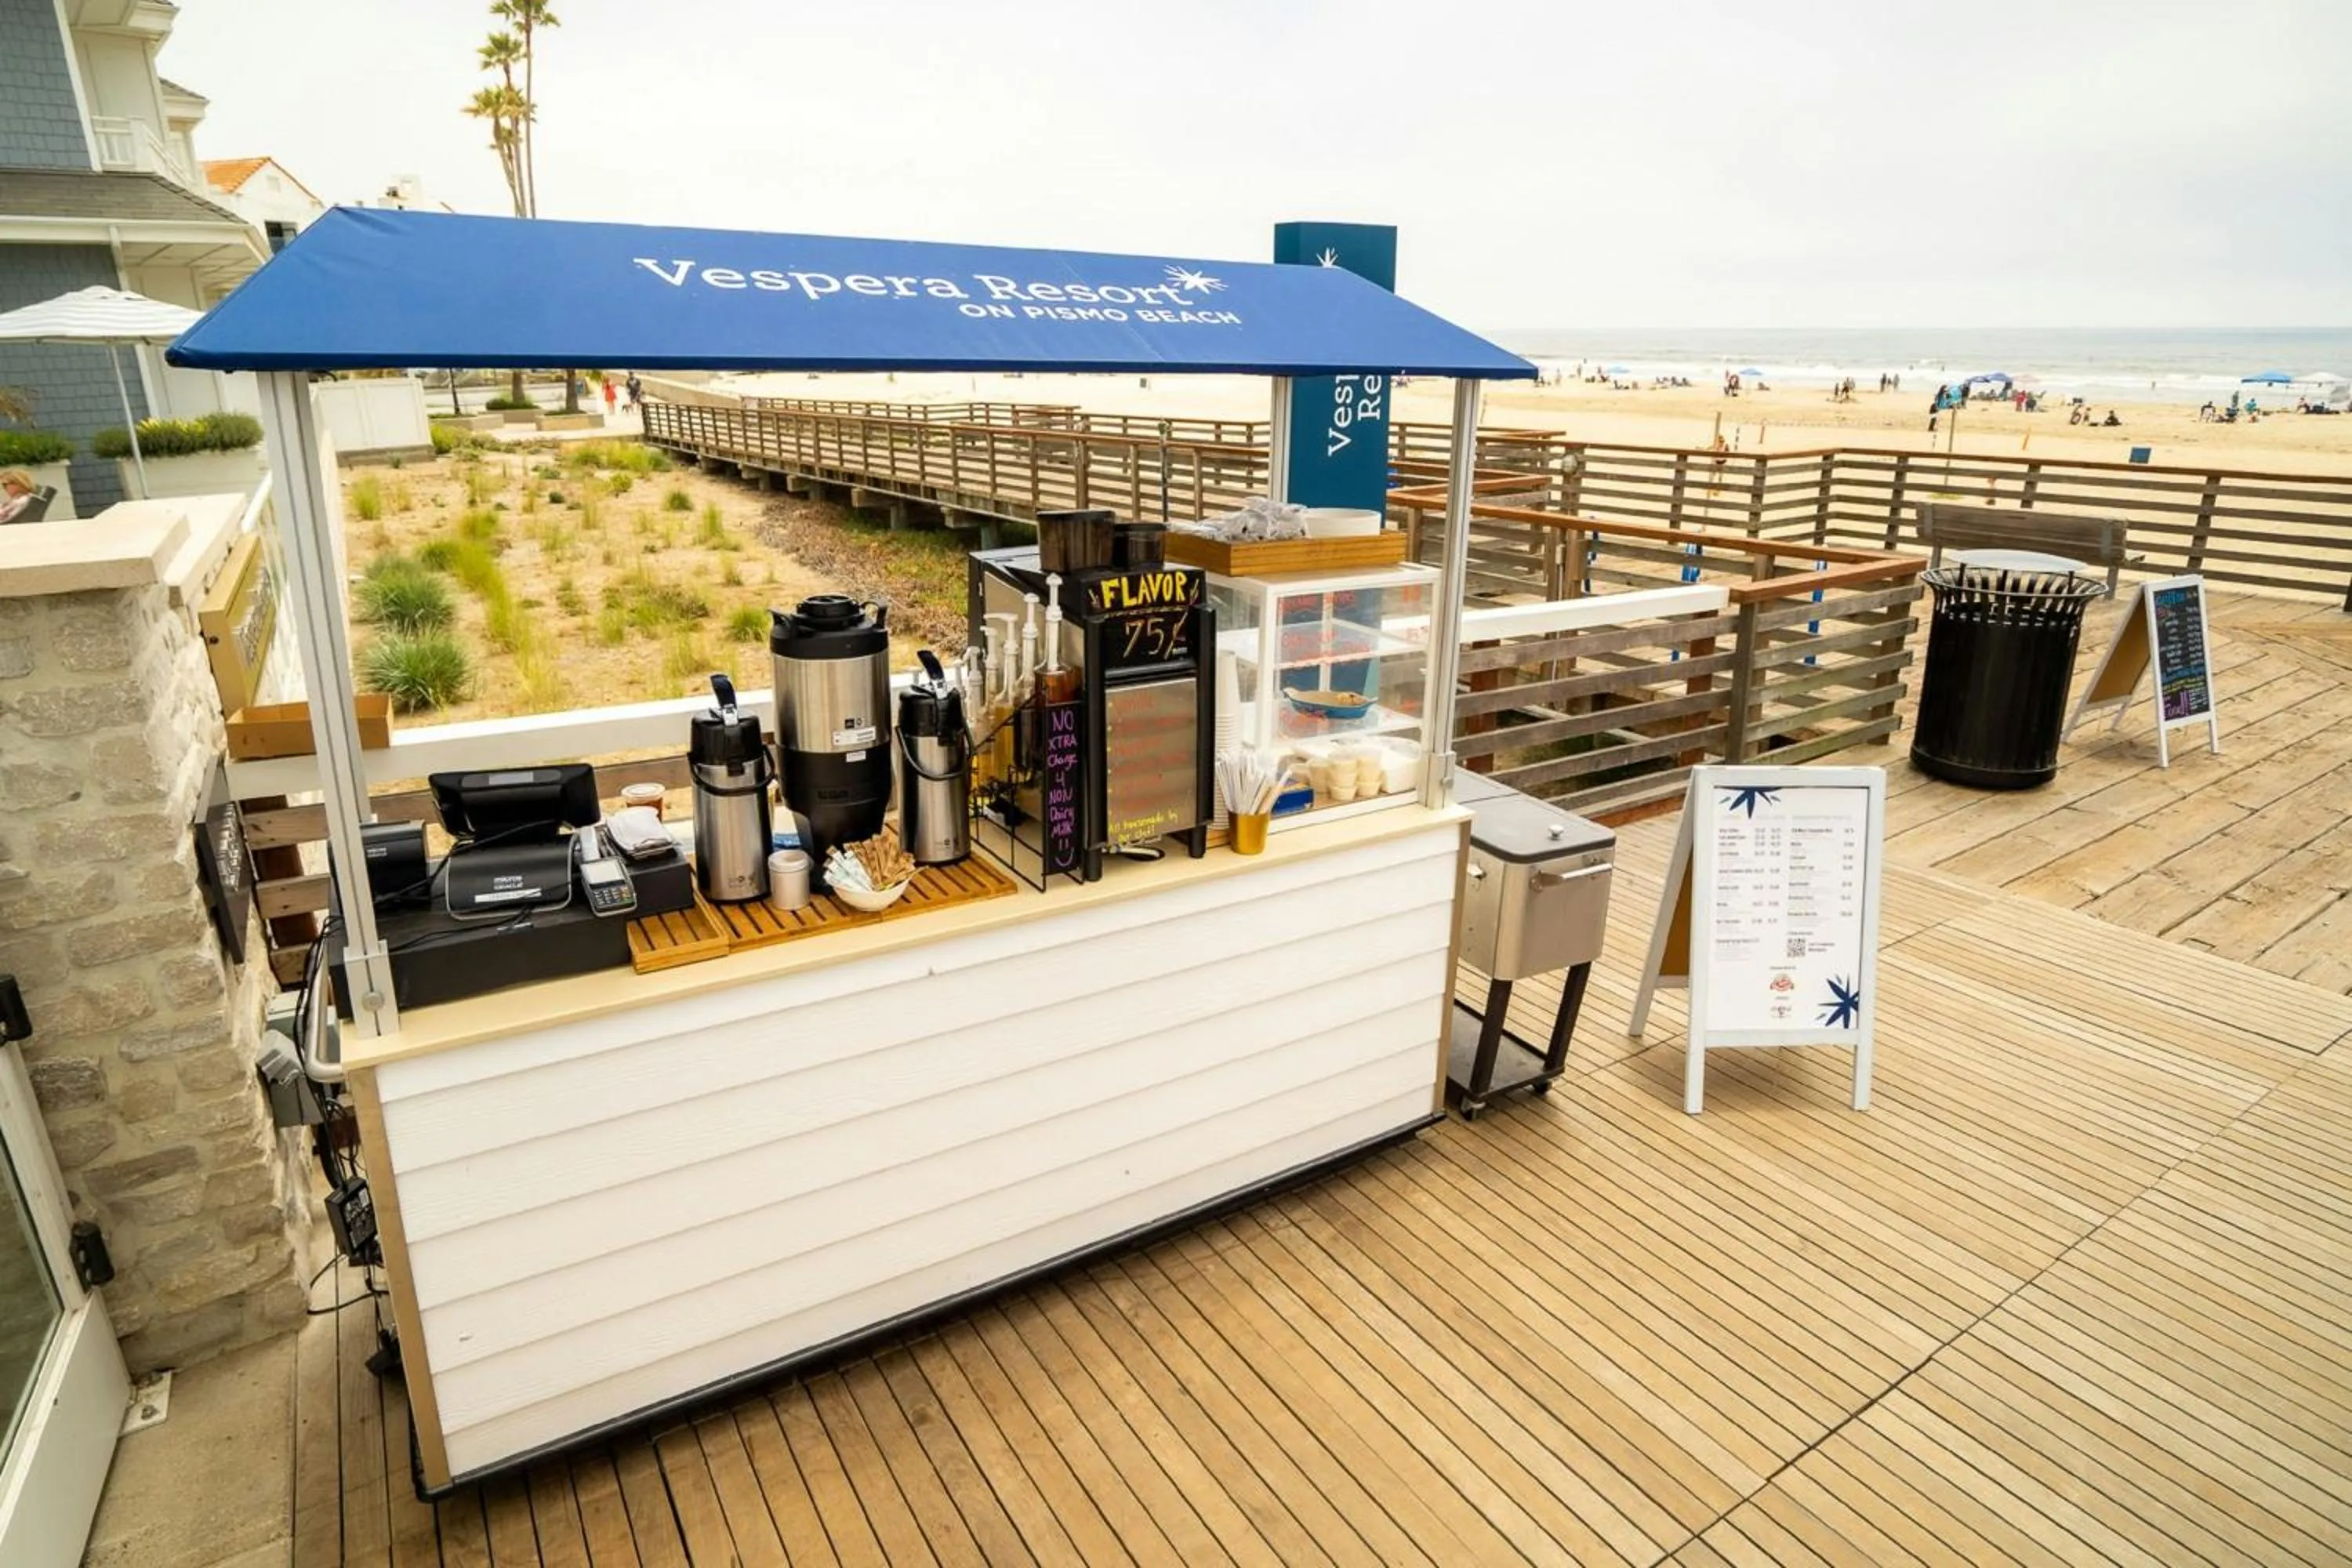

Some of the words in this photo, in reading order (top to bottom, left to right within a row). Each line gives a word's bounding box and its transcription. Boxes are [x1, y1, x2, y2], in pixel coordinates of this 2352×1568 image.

[633, 257, 970, 300] Vespera
[973, 274, 1194, 306] Resort
[959, 303, 1017, 319] ON
[1022, 306, 1129, 323] PISMO
[1134, 308, 1243, 325] BEACH
[1100, 571, 1188, 609] FLAVOR
[1051, 709, 1074, 731] NO
[1048, 733, 1078, 750] XTRA
